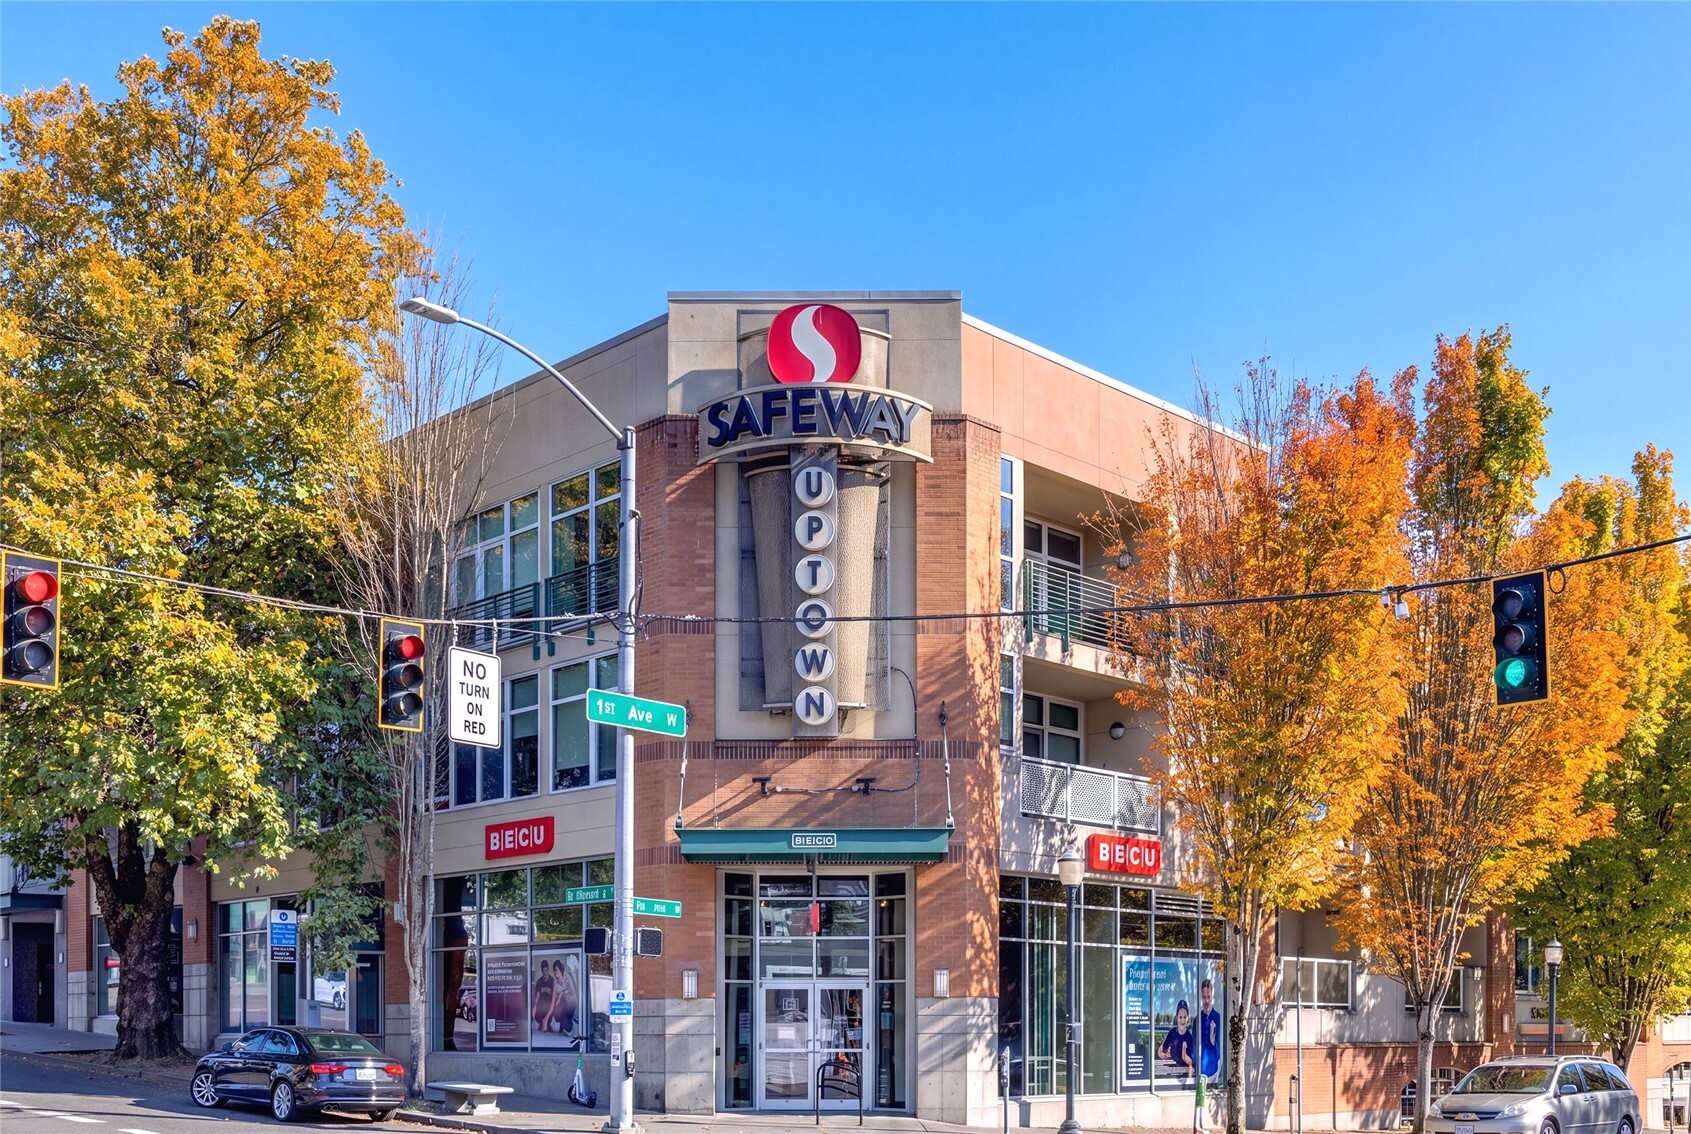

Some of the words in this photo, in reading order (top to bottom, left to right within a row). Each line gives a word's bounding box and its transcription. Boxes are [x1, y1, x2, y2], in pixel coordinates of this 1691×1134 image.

[707, 388, 922, 449] SAFEWAY
[800, 470, 828, 719] UPTOWN
[463, 660, 486, 680] NO
[459, 681, 490, 700] TURN
[467, 702, 483, 717] ON
[596, 698, 616, 716] 1ST
[628, 705, 653, 723] Ave
[666, 712, 678, 727] W
[464, 719, 486, 735] RED
